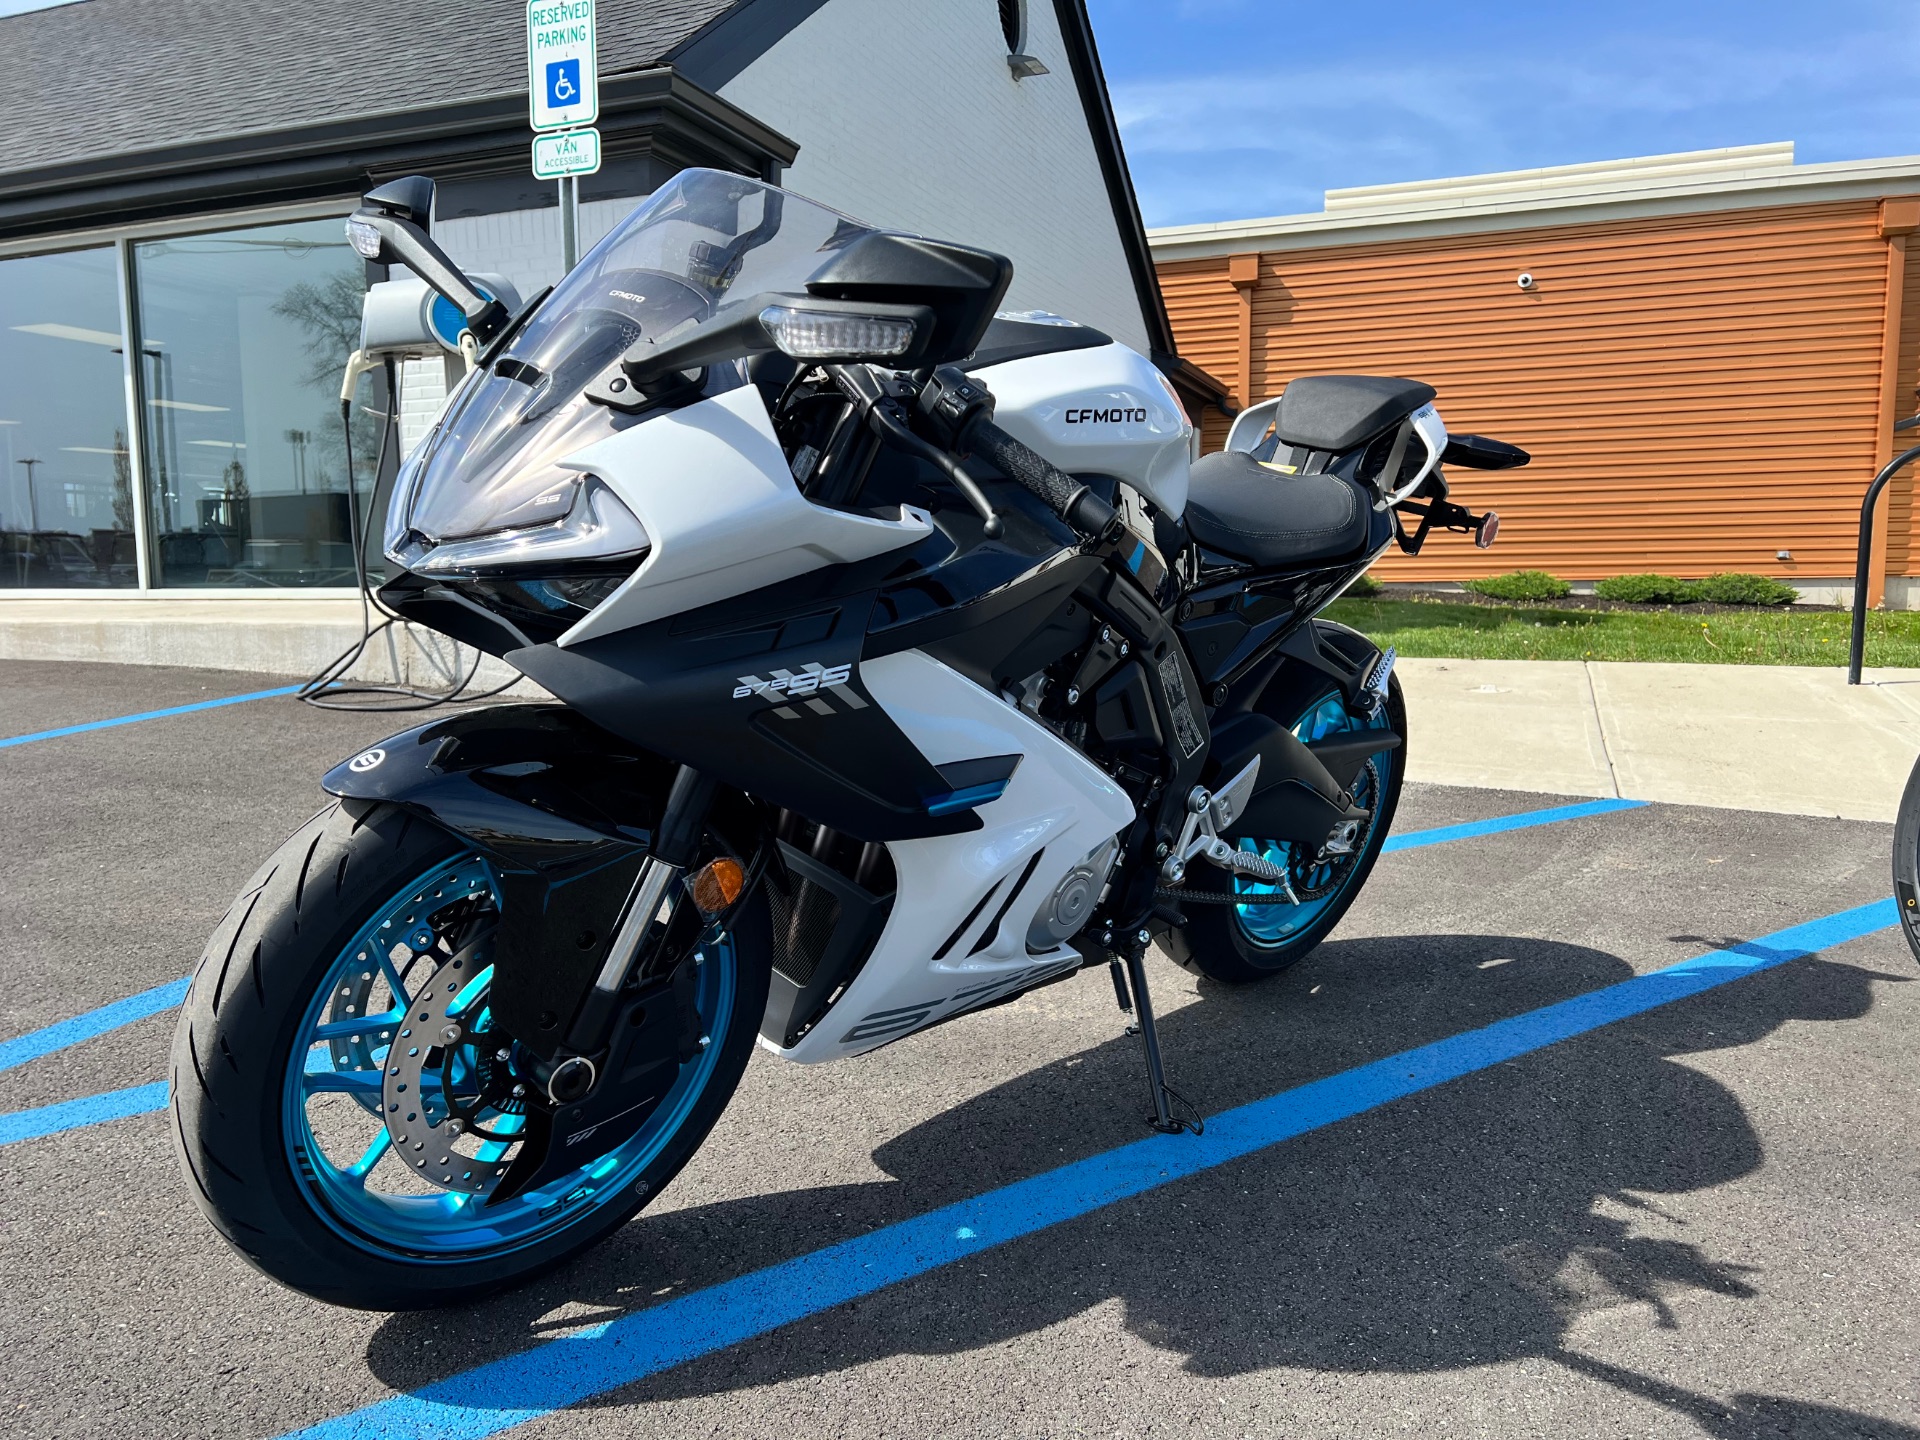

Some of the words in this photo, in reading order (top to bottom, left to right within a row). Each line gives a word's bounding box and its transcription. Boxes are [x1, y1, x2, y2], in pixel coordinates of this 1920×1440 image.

[532, 1, 589, 27] RESERVED
[537, 25, 586, 49] PARKING
[555, 141, 578, 155] VAN
[544, 154, 589, 168] ACCESSIBLE
[608, 289, 646, 303] CFMOTO
[1065, 408, 1147, 423] CFMOTO
[534, 493, 562, 506] SS
